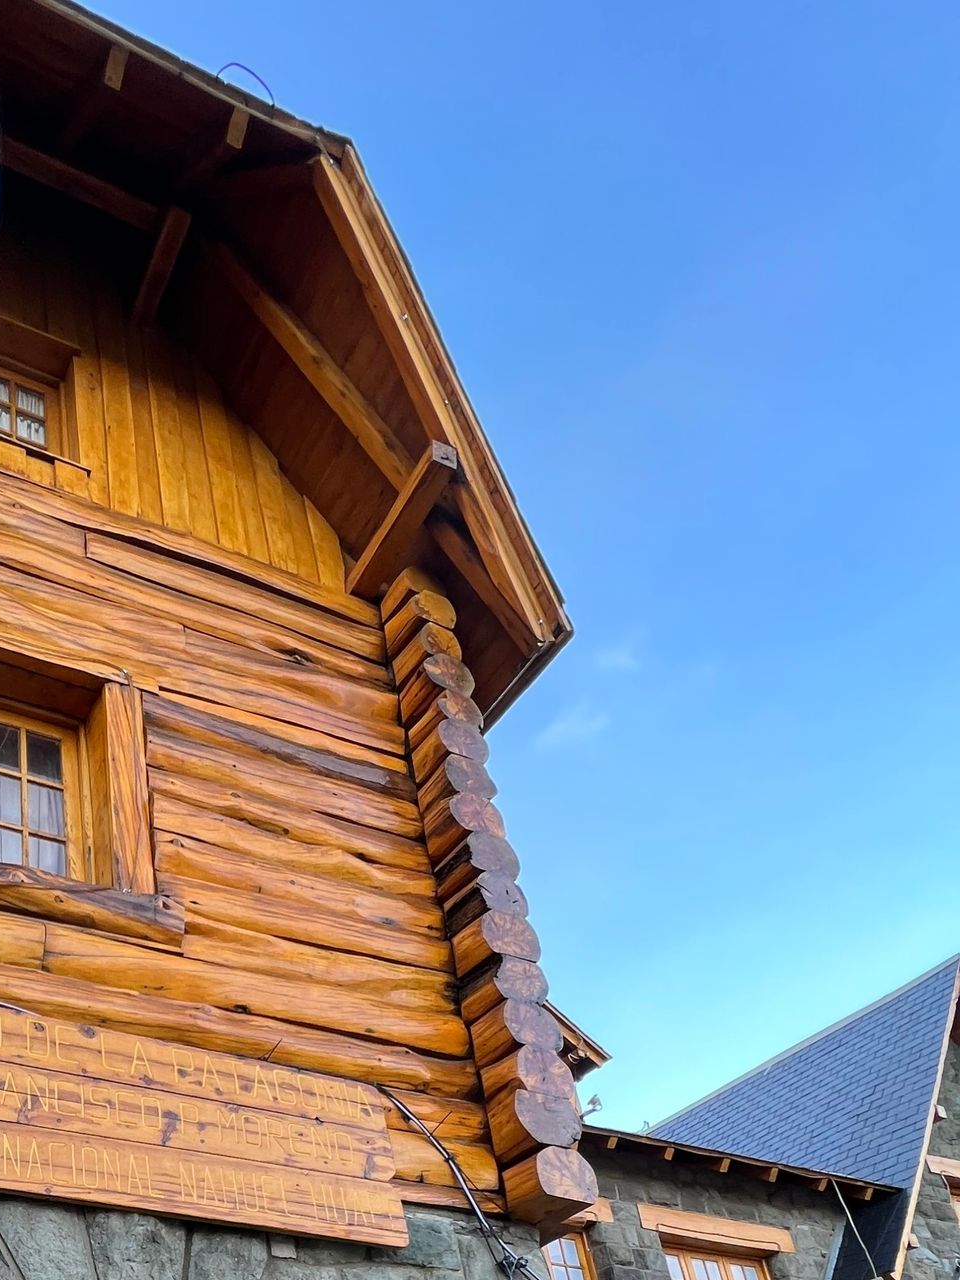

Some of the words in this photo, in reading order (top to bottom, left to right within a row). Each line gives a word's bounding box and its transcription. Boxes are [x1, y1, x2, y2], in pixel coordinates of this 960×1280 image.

[27, 1020, 79, 1065] DE
[101, 1032, 152, 1079] LA
[171, 1048, 375, 1119] PATAGONIA
[2, 1134, 165, 1198] NACIONAL
[179, 1161, 292, 1216] NAHUEL
[311, 1183, 396, 1231] HUAPI
[216, 1109, 353, 1164] MORENO
